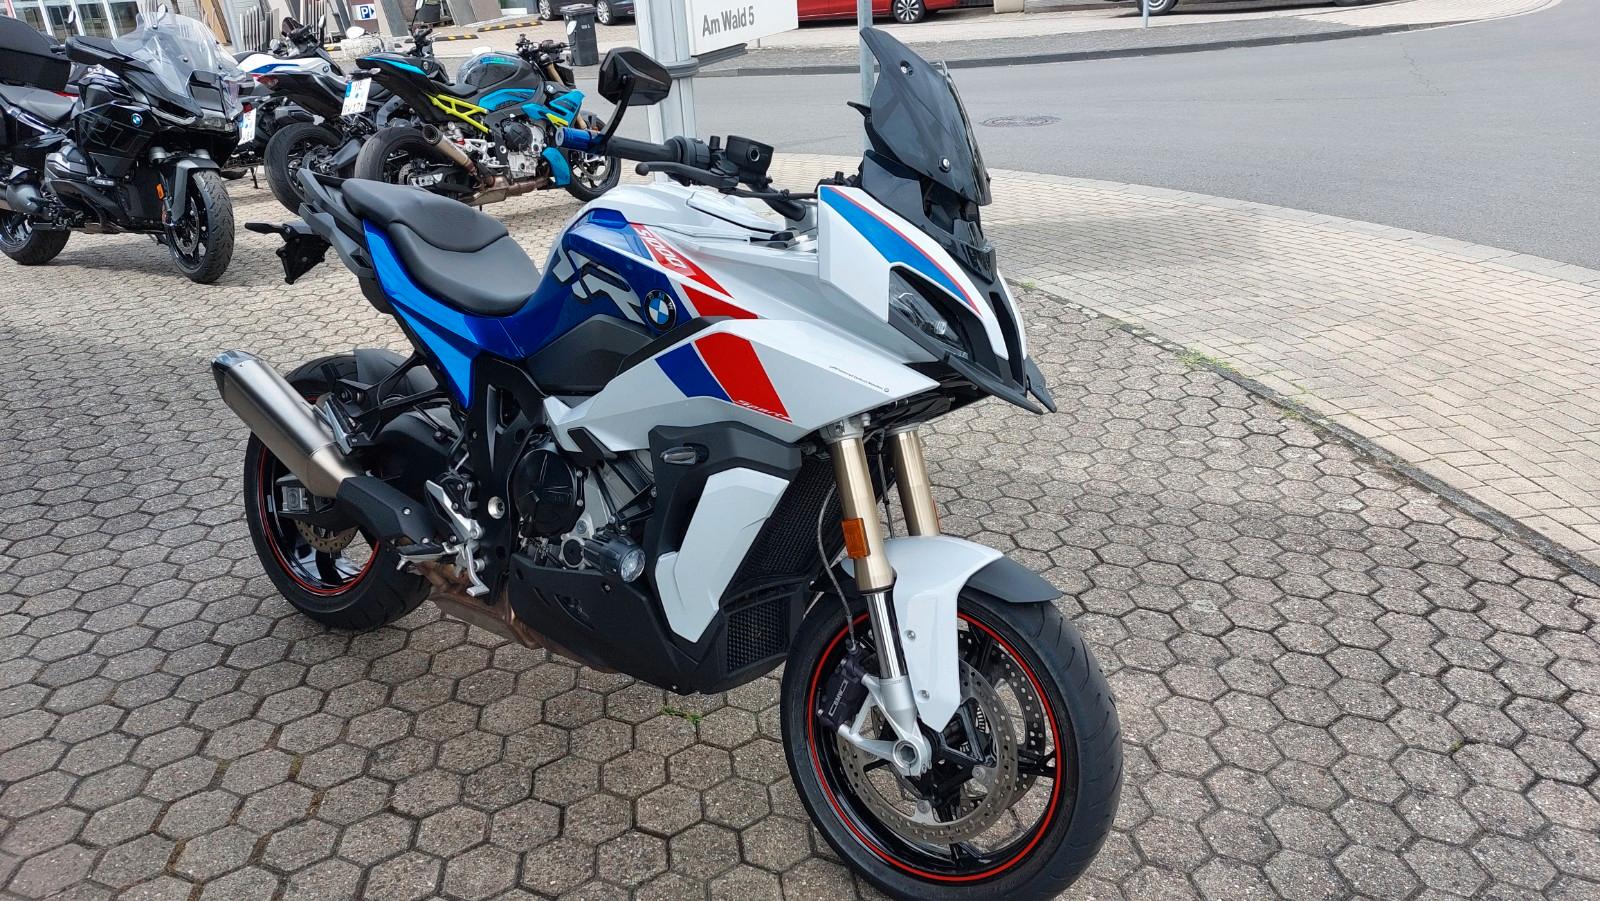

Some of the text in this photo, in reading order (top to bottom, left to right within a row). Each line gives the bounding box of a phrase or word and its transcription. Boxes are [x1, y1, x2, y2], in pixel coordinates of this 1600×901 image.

[361, 7, 369, 18] P
[702, 5, 754, 37] Am Wald 5
